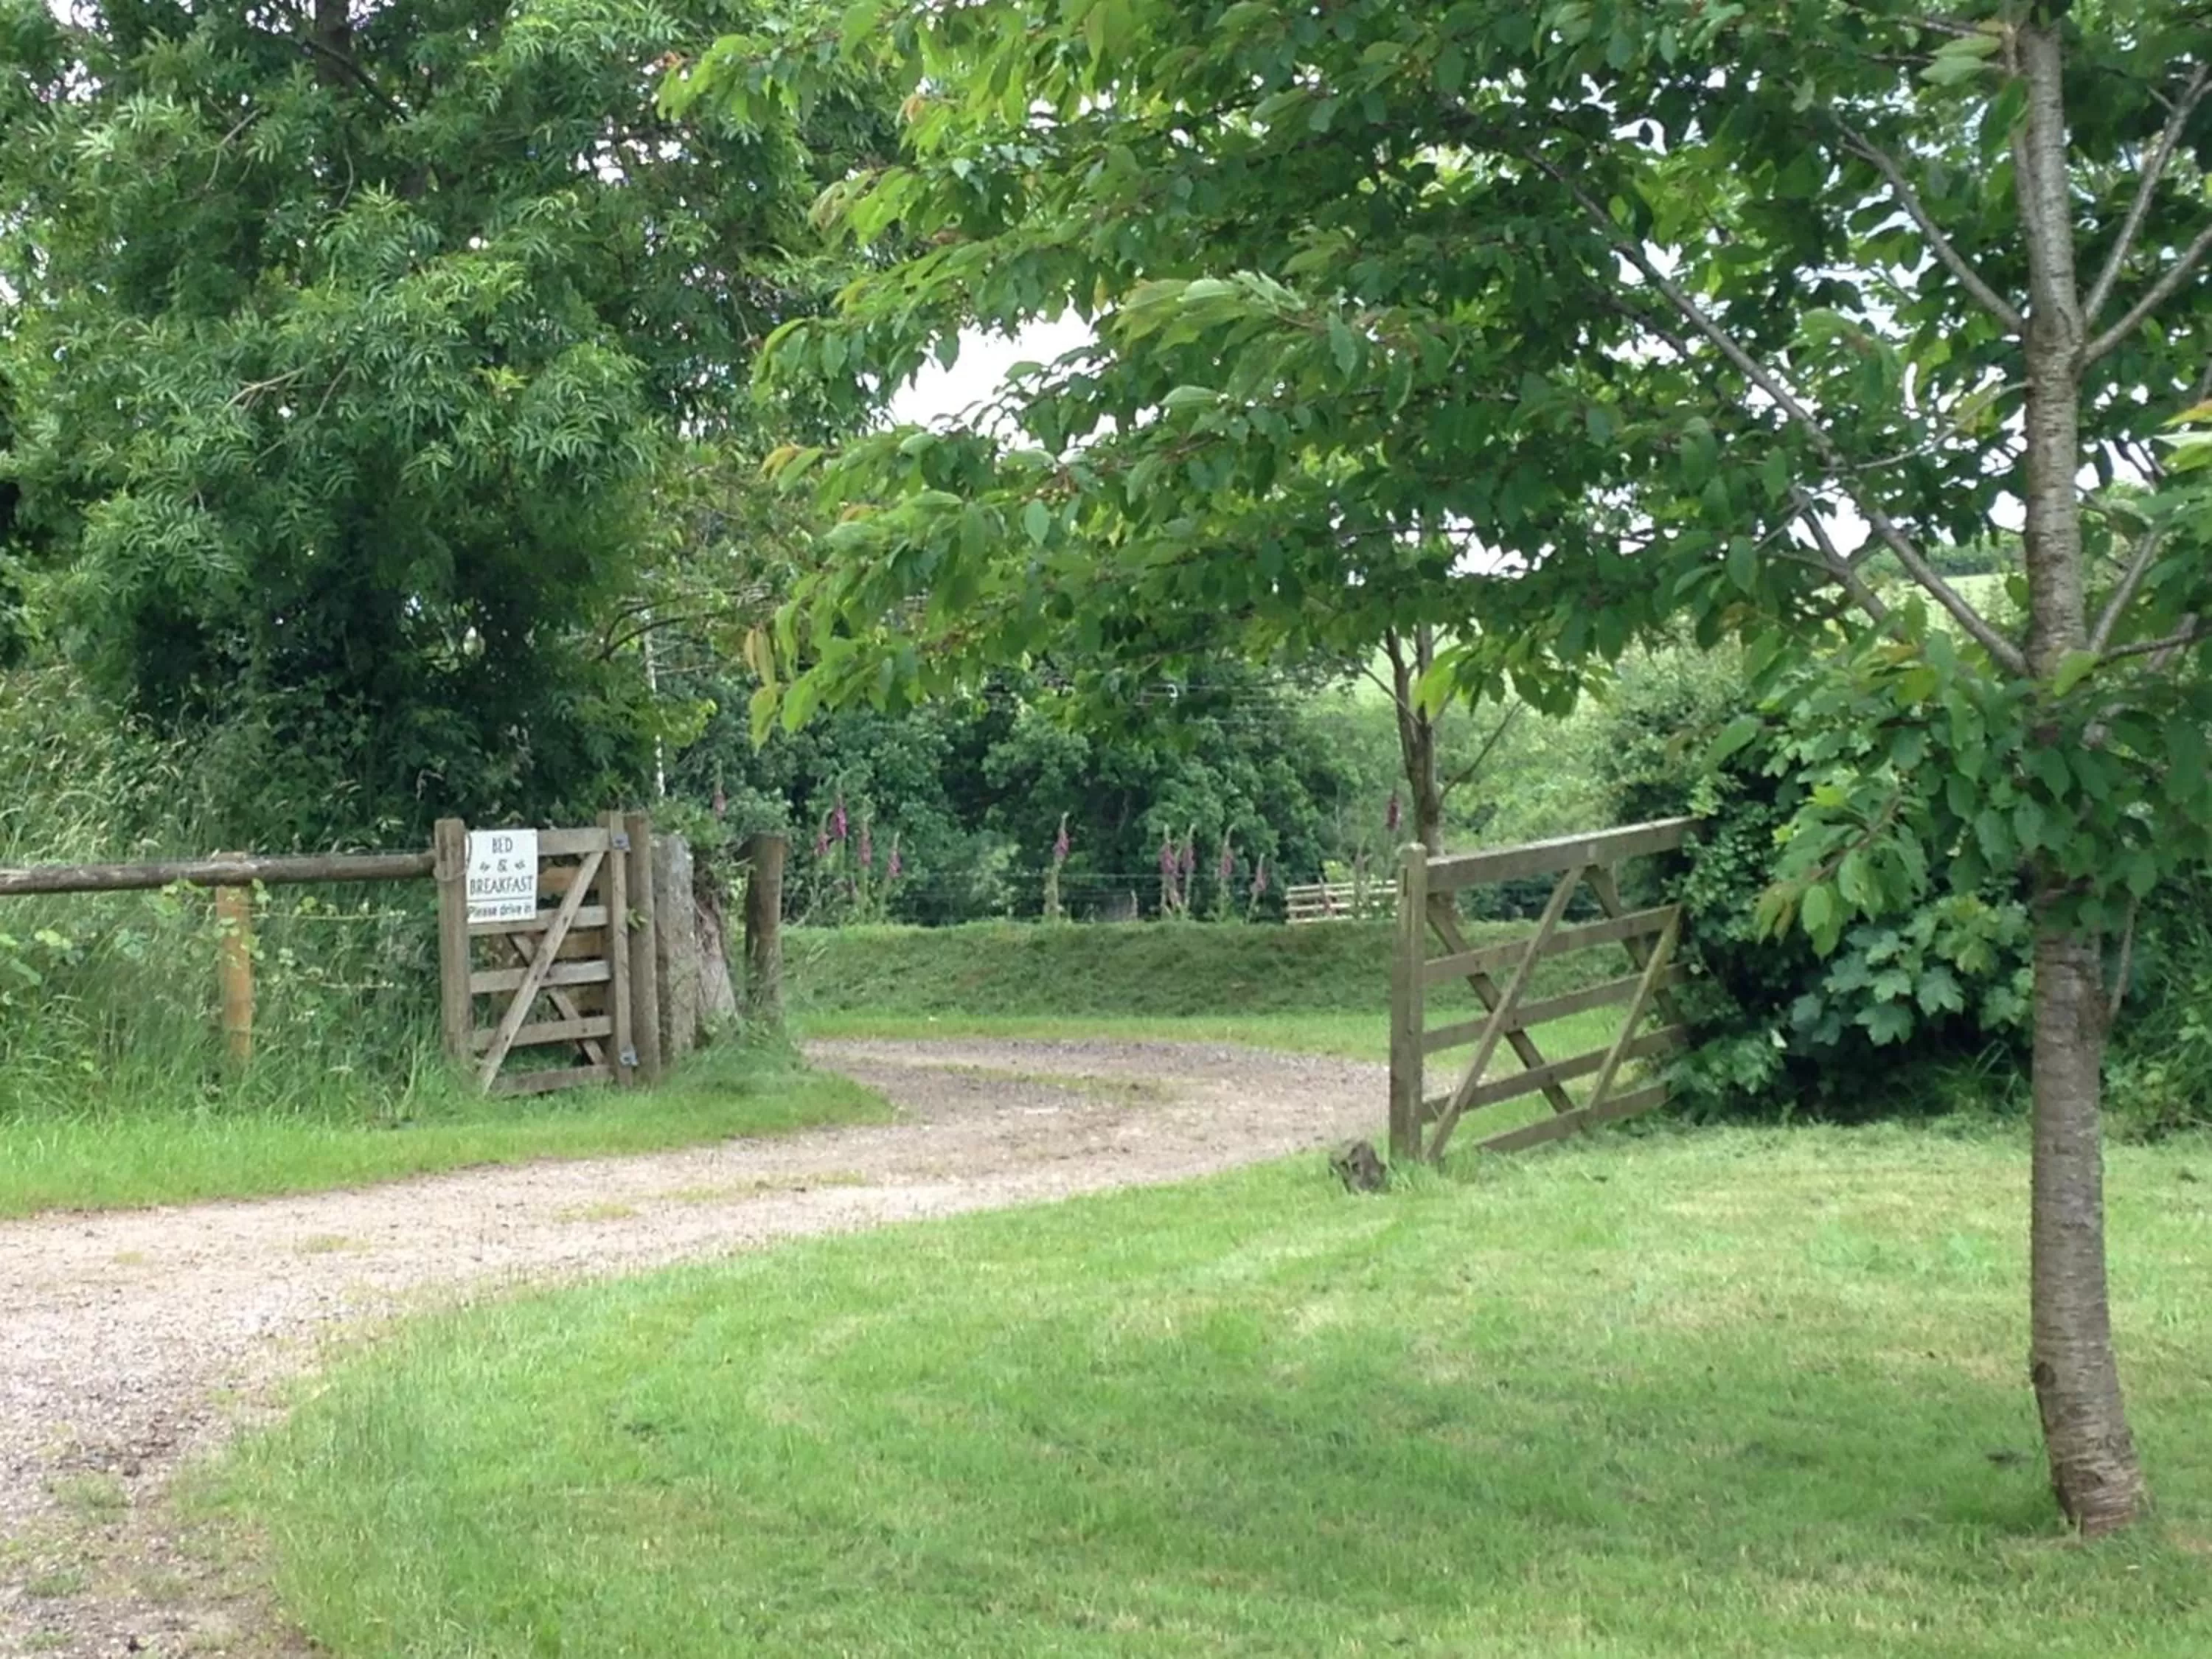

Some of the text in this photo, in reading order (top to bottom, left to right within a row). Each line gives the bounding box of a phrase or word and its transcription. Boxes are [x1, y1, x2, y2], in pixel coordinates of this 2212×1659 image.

[492, 837, 513, 854] BED
[497, 859, 507, 872] &
[470, 875, 533, 895] BREAKFAST
